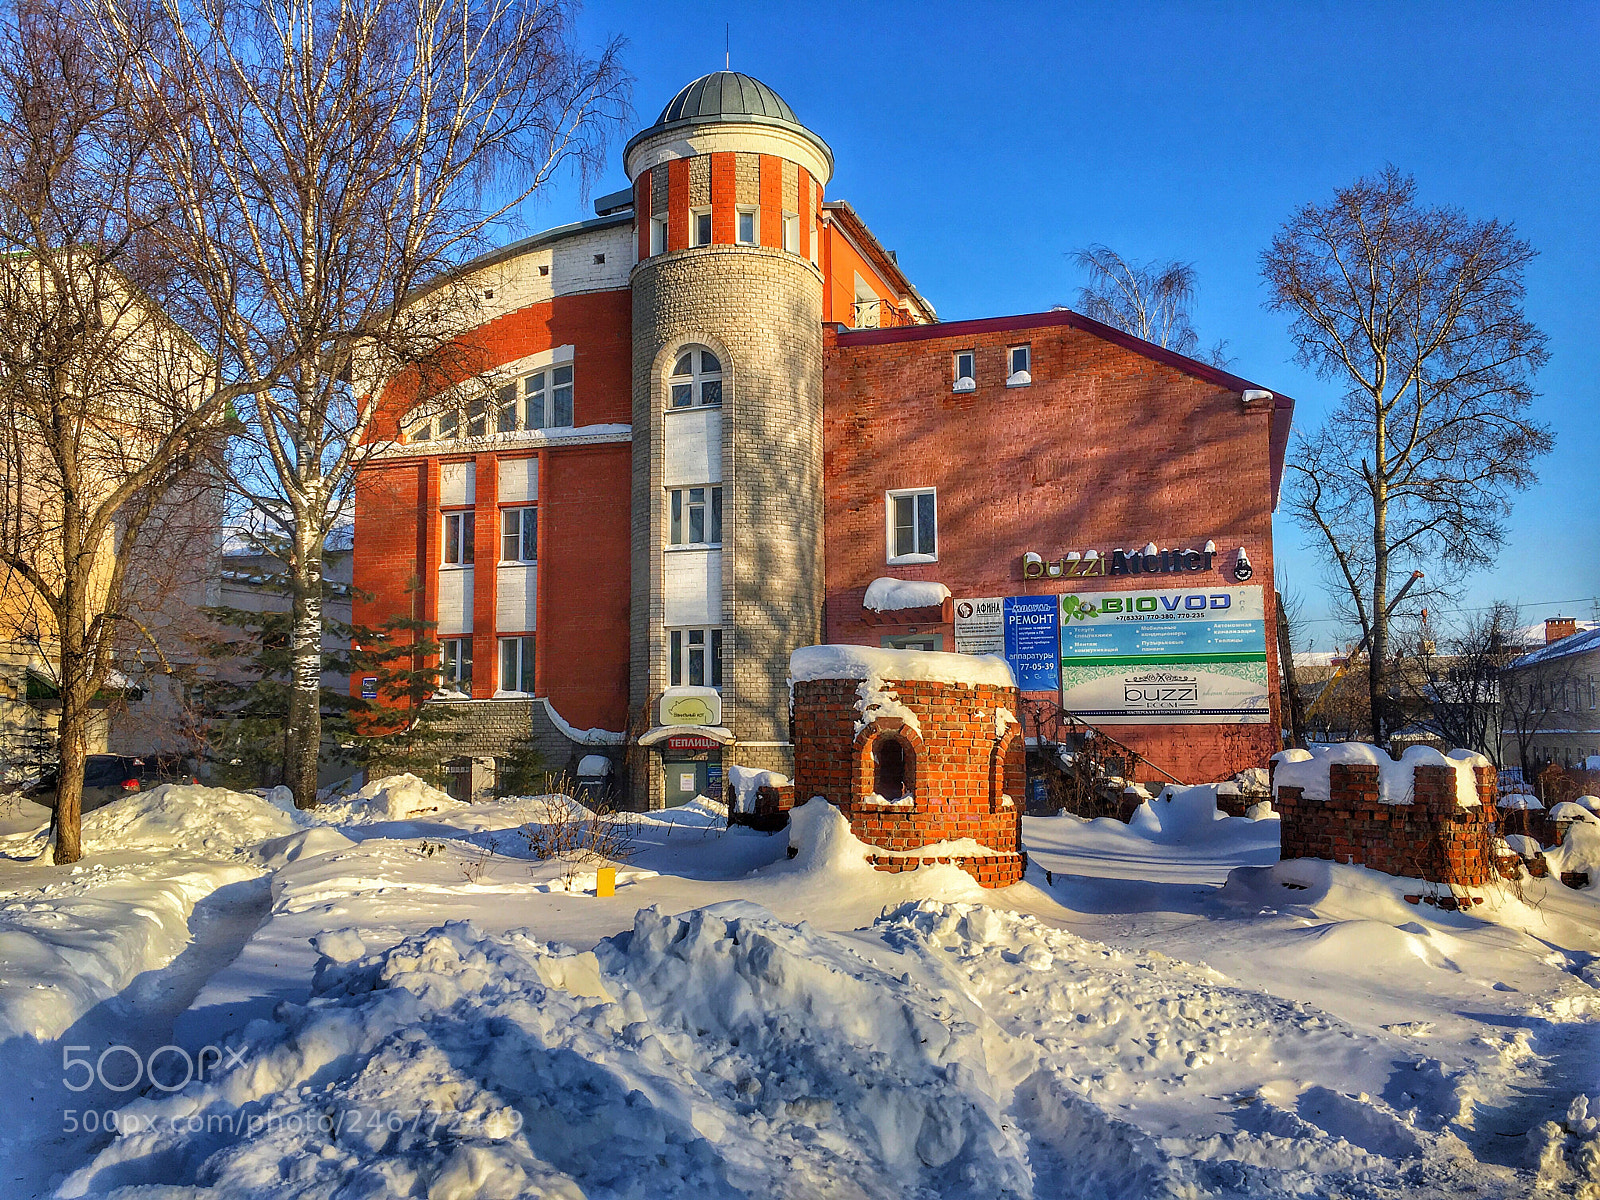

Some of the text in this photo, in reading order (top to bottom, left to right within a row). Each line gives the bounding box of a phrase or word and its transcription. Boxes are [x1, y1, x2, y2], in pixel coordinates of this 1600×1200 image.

[976, 602, 1001, 614] АФИНА
[1102, 594, 1231, 613] BIOVOD
[1009, 613, 1055, 625] РЕМОНТ
[1009, 652, 1054, 660] аппаратуры
[1020, 662, 1055, 671] 77-05-39
[1124, 684, 1198, 702] buzzi
[670, 738, 719, 748] ТЕПЛИЦЫ
